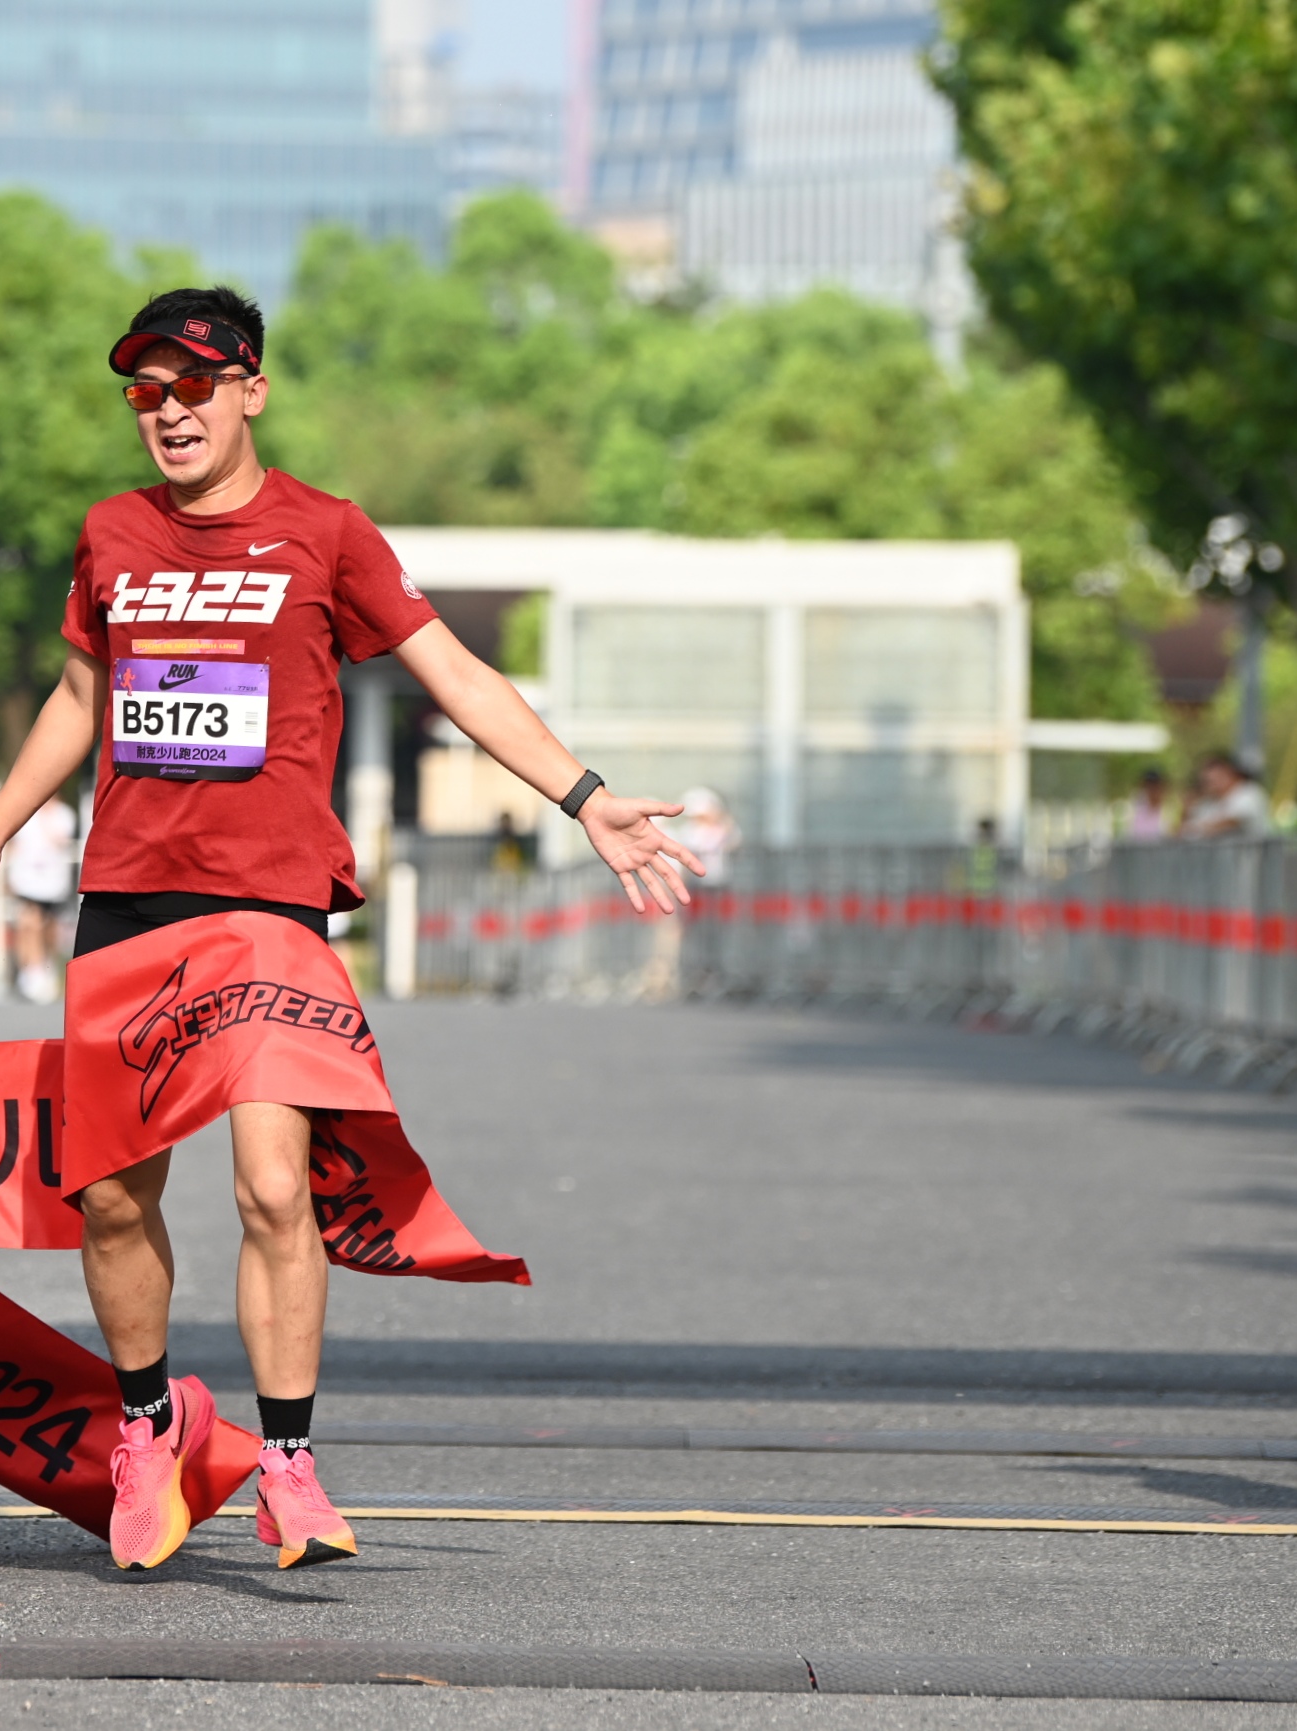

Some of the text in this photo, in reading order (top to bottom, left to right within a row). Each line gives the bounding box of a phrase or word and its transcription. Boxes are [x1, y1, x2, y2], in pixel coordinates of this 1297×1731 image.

[166, 664, 199, 679] RUN
[122, 699, 229, 738] B5173
[136, 745, 227, 761] 耐克少儿跑2024
